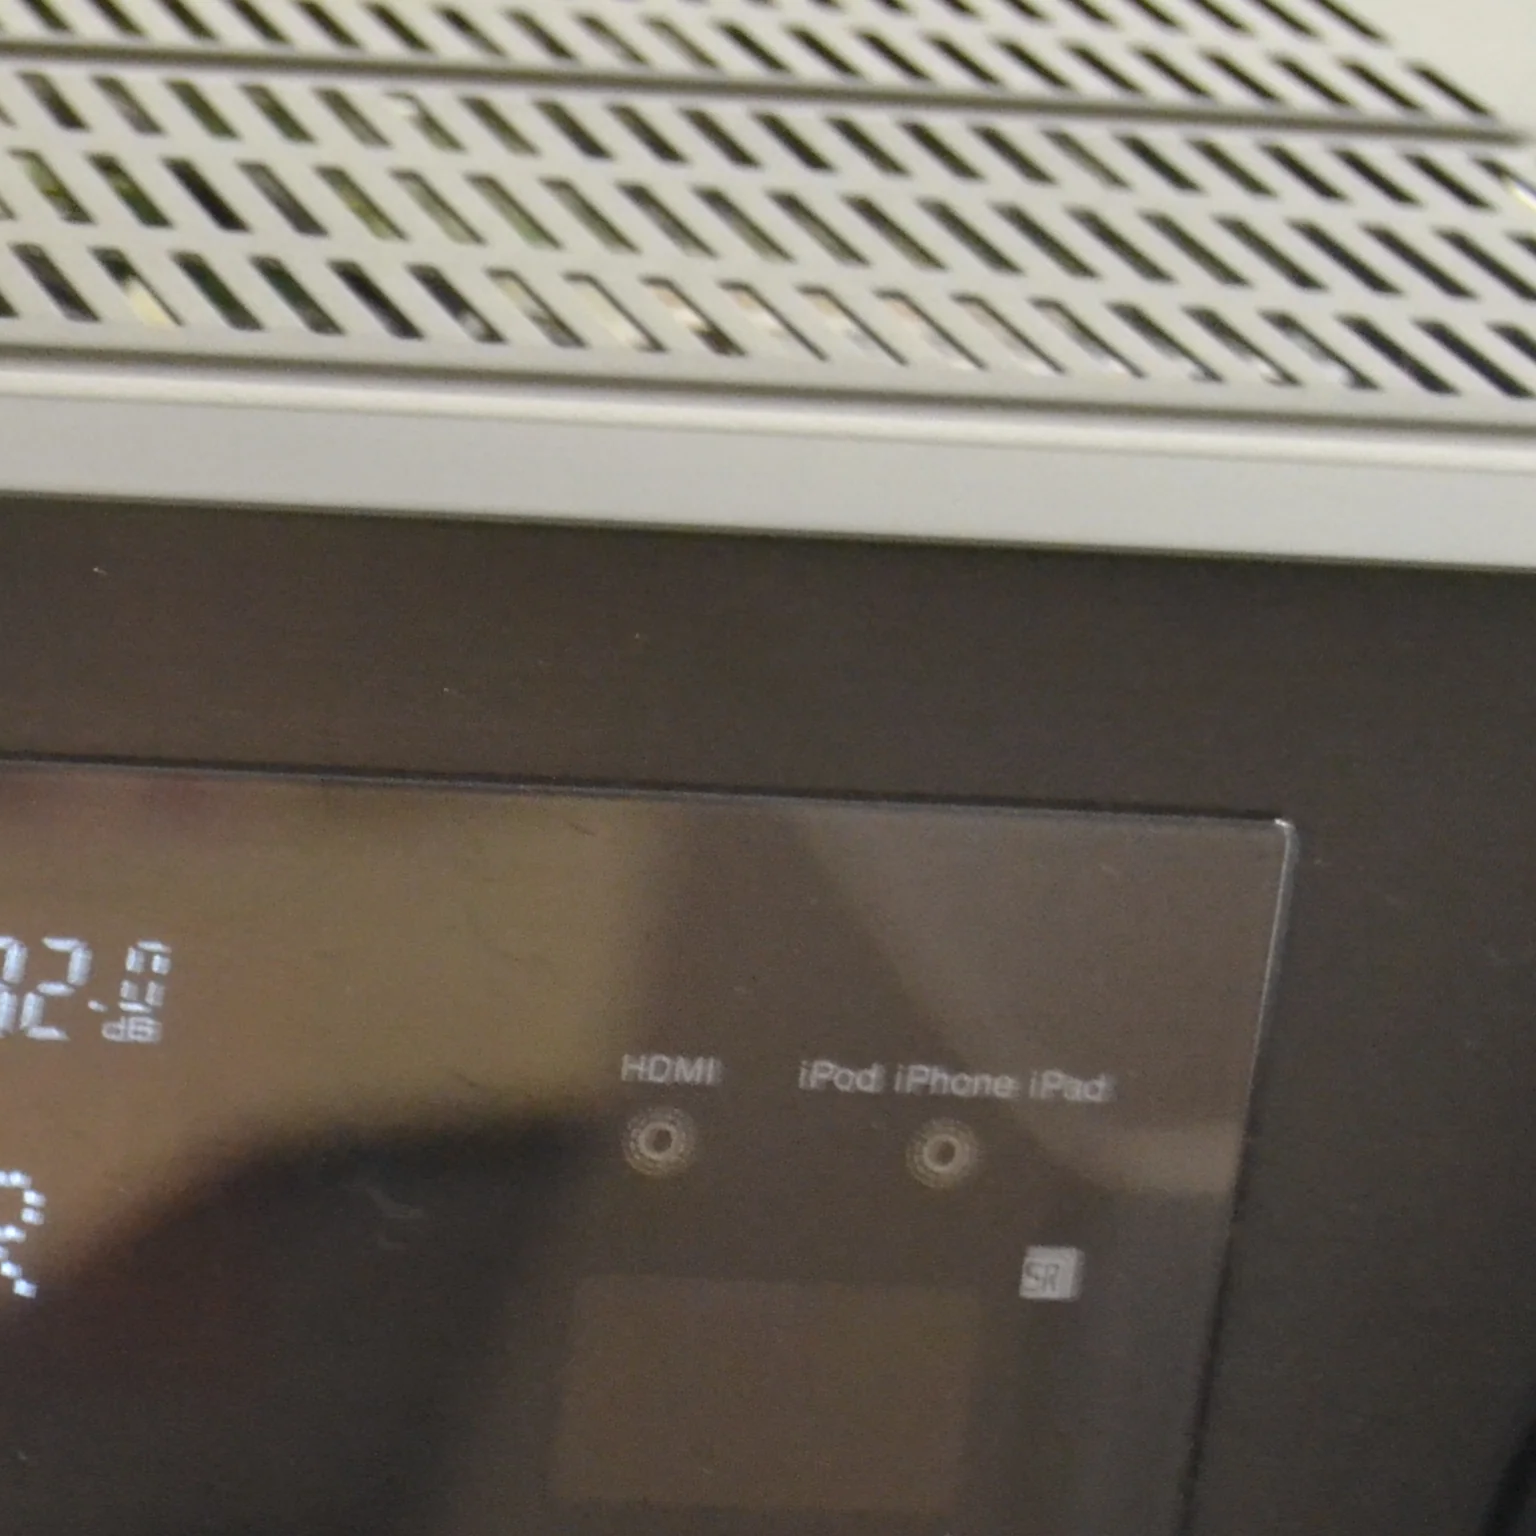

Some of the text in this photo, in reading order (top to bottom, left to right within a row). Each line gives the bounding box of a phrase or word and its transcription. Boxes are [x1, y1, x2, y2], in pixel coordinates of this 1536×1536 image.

[620, 1054, 719, 1085] HDMI
[798, 1060, 1112, 1102] iPod iPhone iPad
